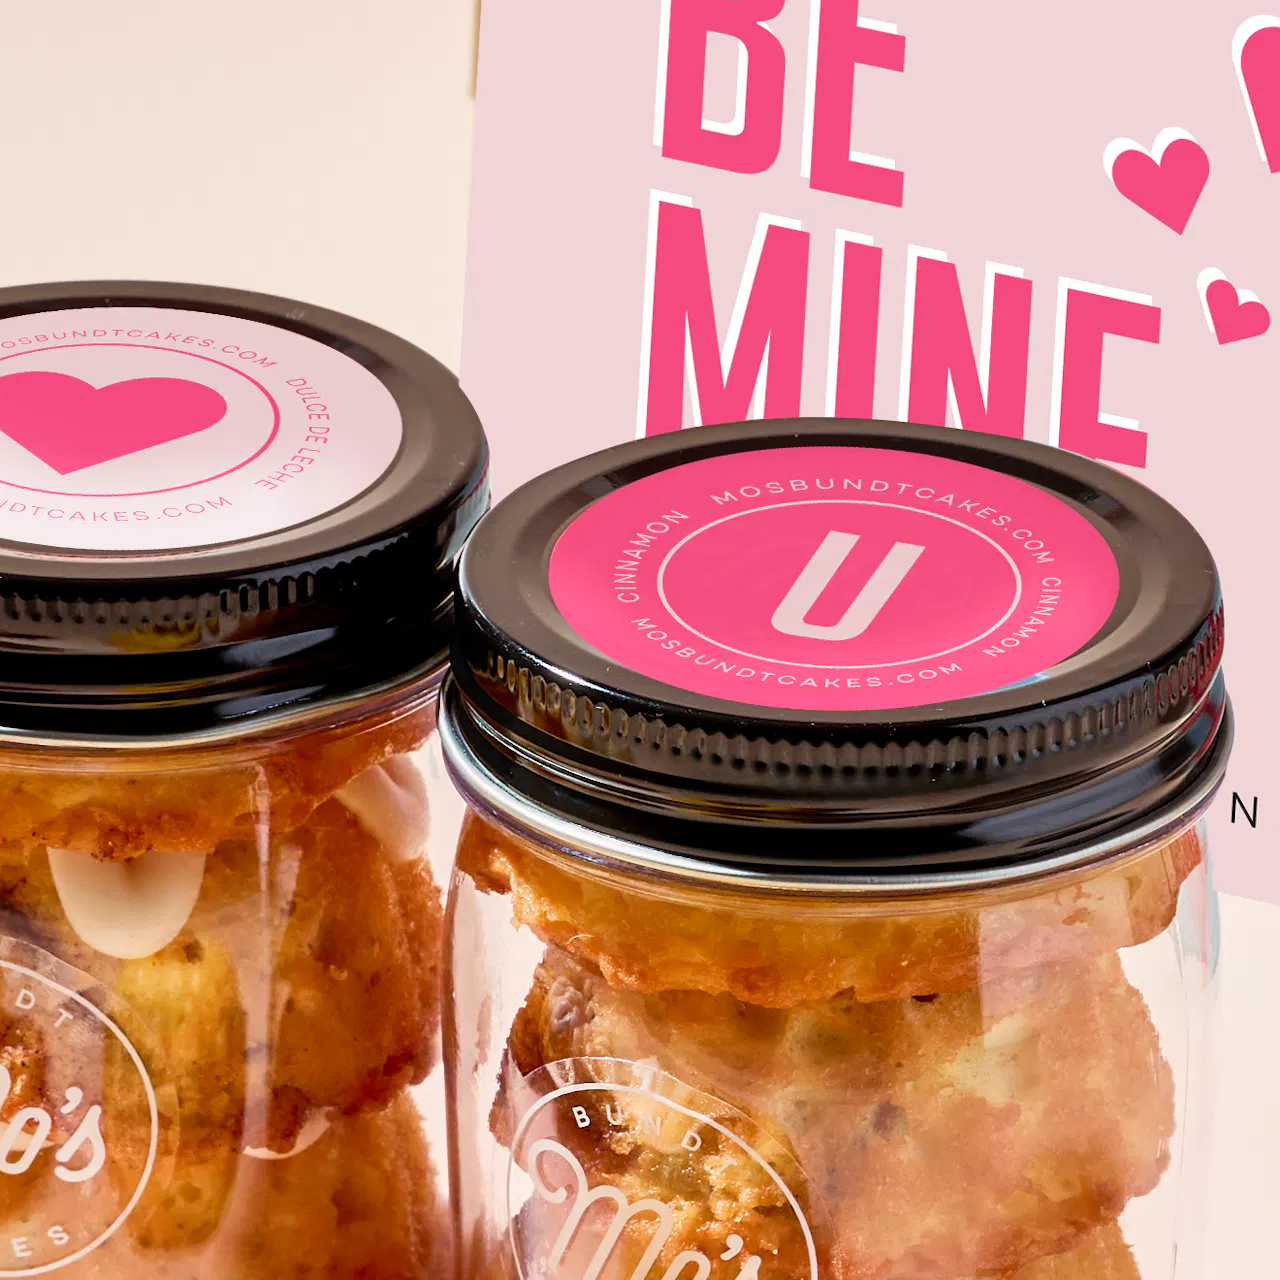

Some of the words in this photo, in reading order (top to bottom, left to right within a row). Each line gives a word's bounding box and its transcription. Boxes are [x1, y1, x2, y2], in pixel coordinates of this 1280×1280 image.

[636, 187, 1162, 470] MINE
[285, 377, 330, 421] DULCE
[305, 426, 330, 444] DE
[254, 447, 321, 491] LECHE
[614, 509, 689, 603] CINNAMON
[709, 478, 1056, 564] MOSBUNDTCAKES.COM
[771, 530, 926, 641] U
[982, 577, 1062, 658] CINNAMON
[631, 617, 963, 688] MOSBUNDTCAKES.COM
[571, 1103, 738, 1173] BUNDT
